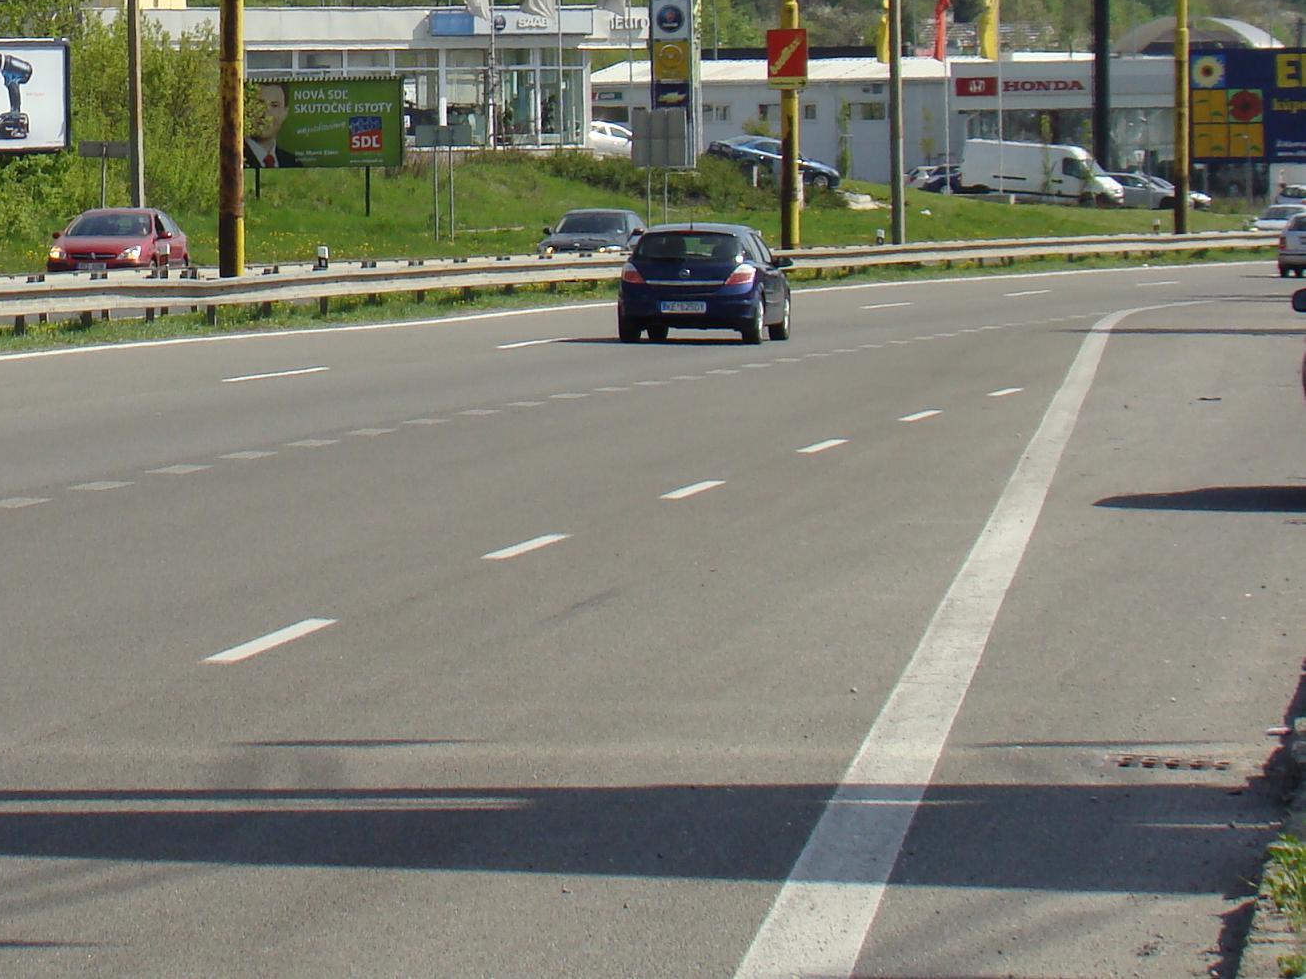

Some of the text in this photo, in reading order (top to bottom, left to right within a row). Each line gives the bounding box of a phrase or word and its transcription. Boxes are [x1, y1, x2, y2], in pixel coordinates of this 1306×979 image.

[517, 17, 549, 29] SAAB
[1002, 80, 1085, 91] HONDA
[294, 88, 325, 100] NOVÁ
[294, 101, 392, 114] SKUTOČNÉ ISTOTY
